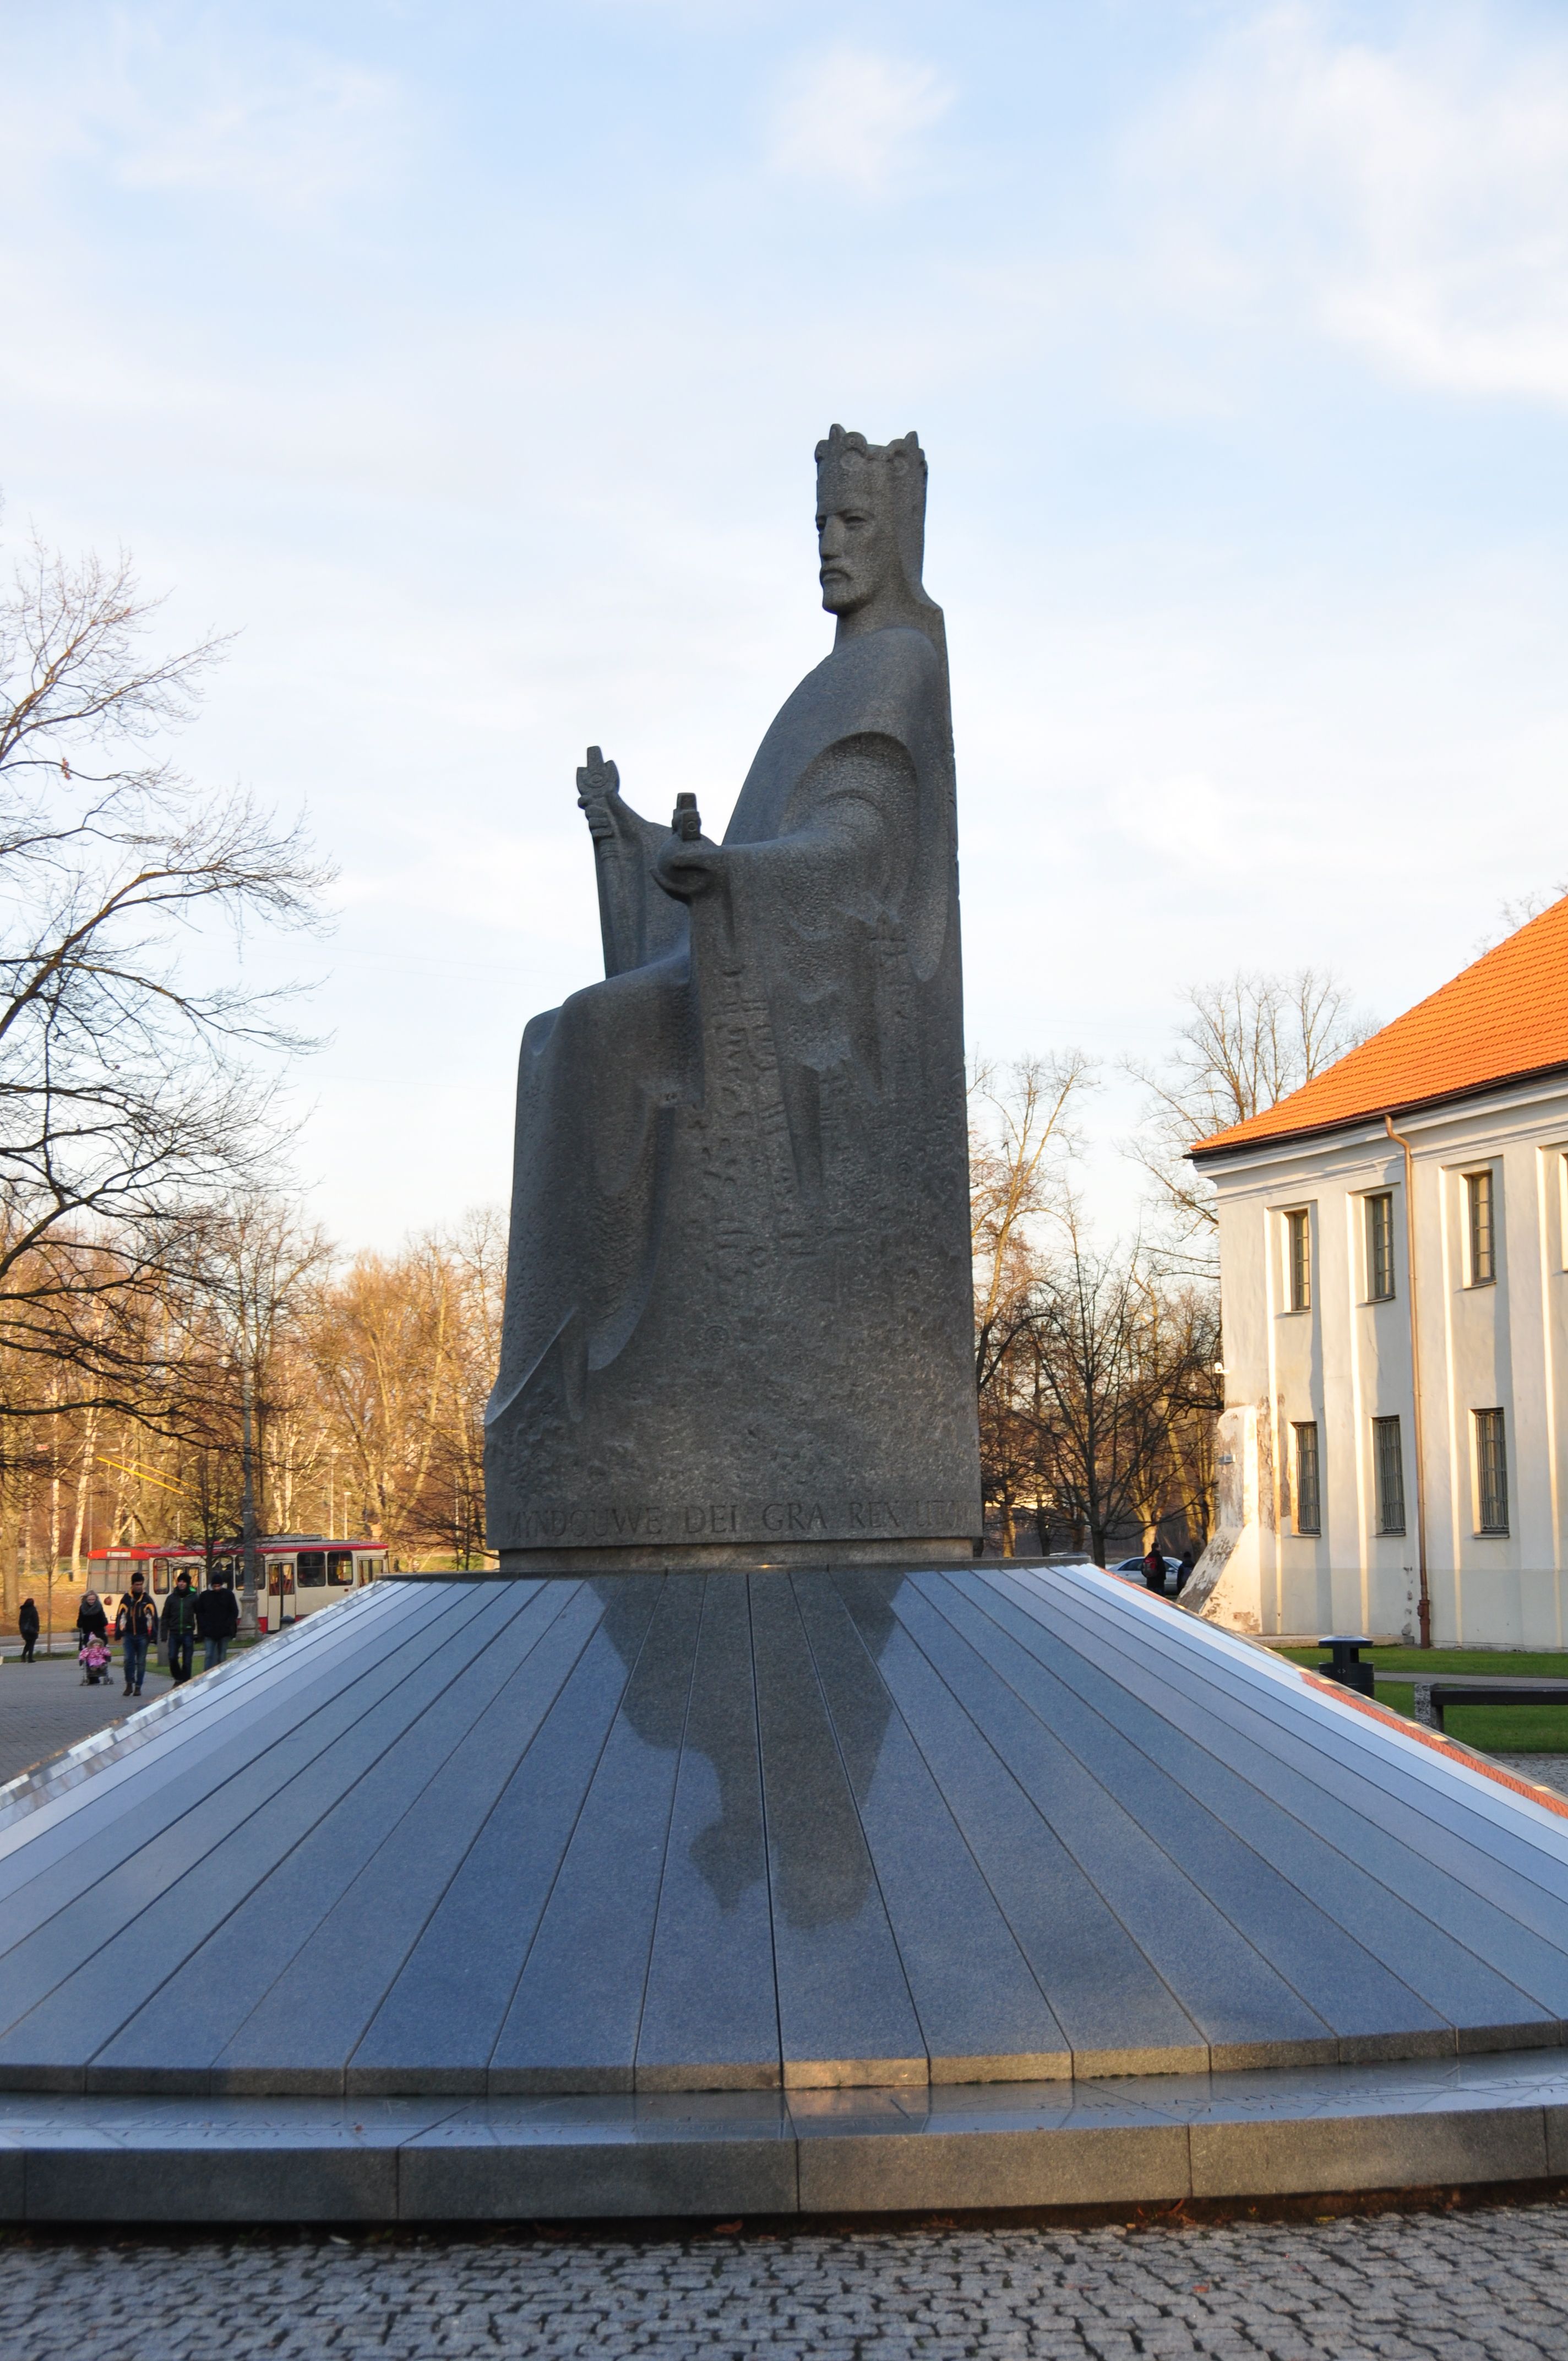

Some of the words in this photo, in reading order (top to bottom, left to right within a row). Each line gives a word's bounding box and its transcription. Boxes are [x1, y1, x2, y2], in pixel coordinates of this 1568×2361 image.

[684, 1504, 738, 1533] DEI
[761, 1502, 828, 1531] GRA
[849, 1499, 901, 1528] REX
